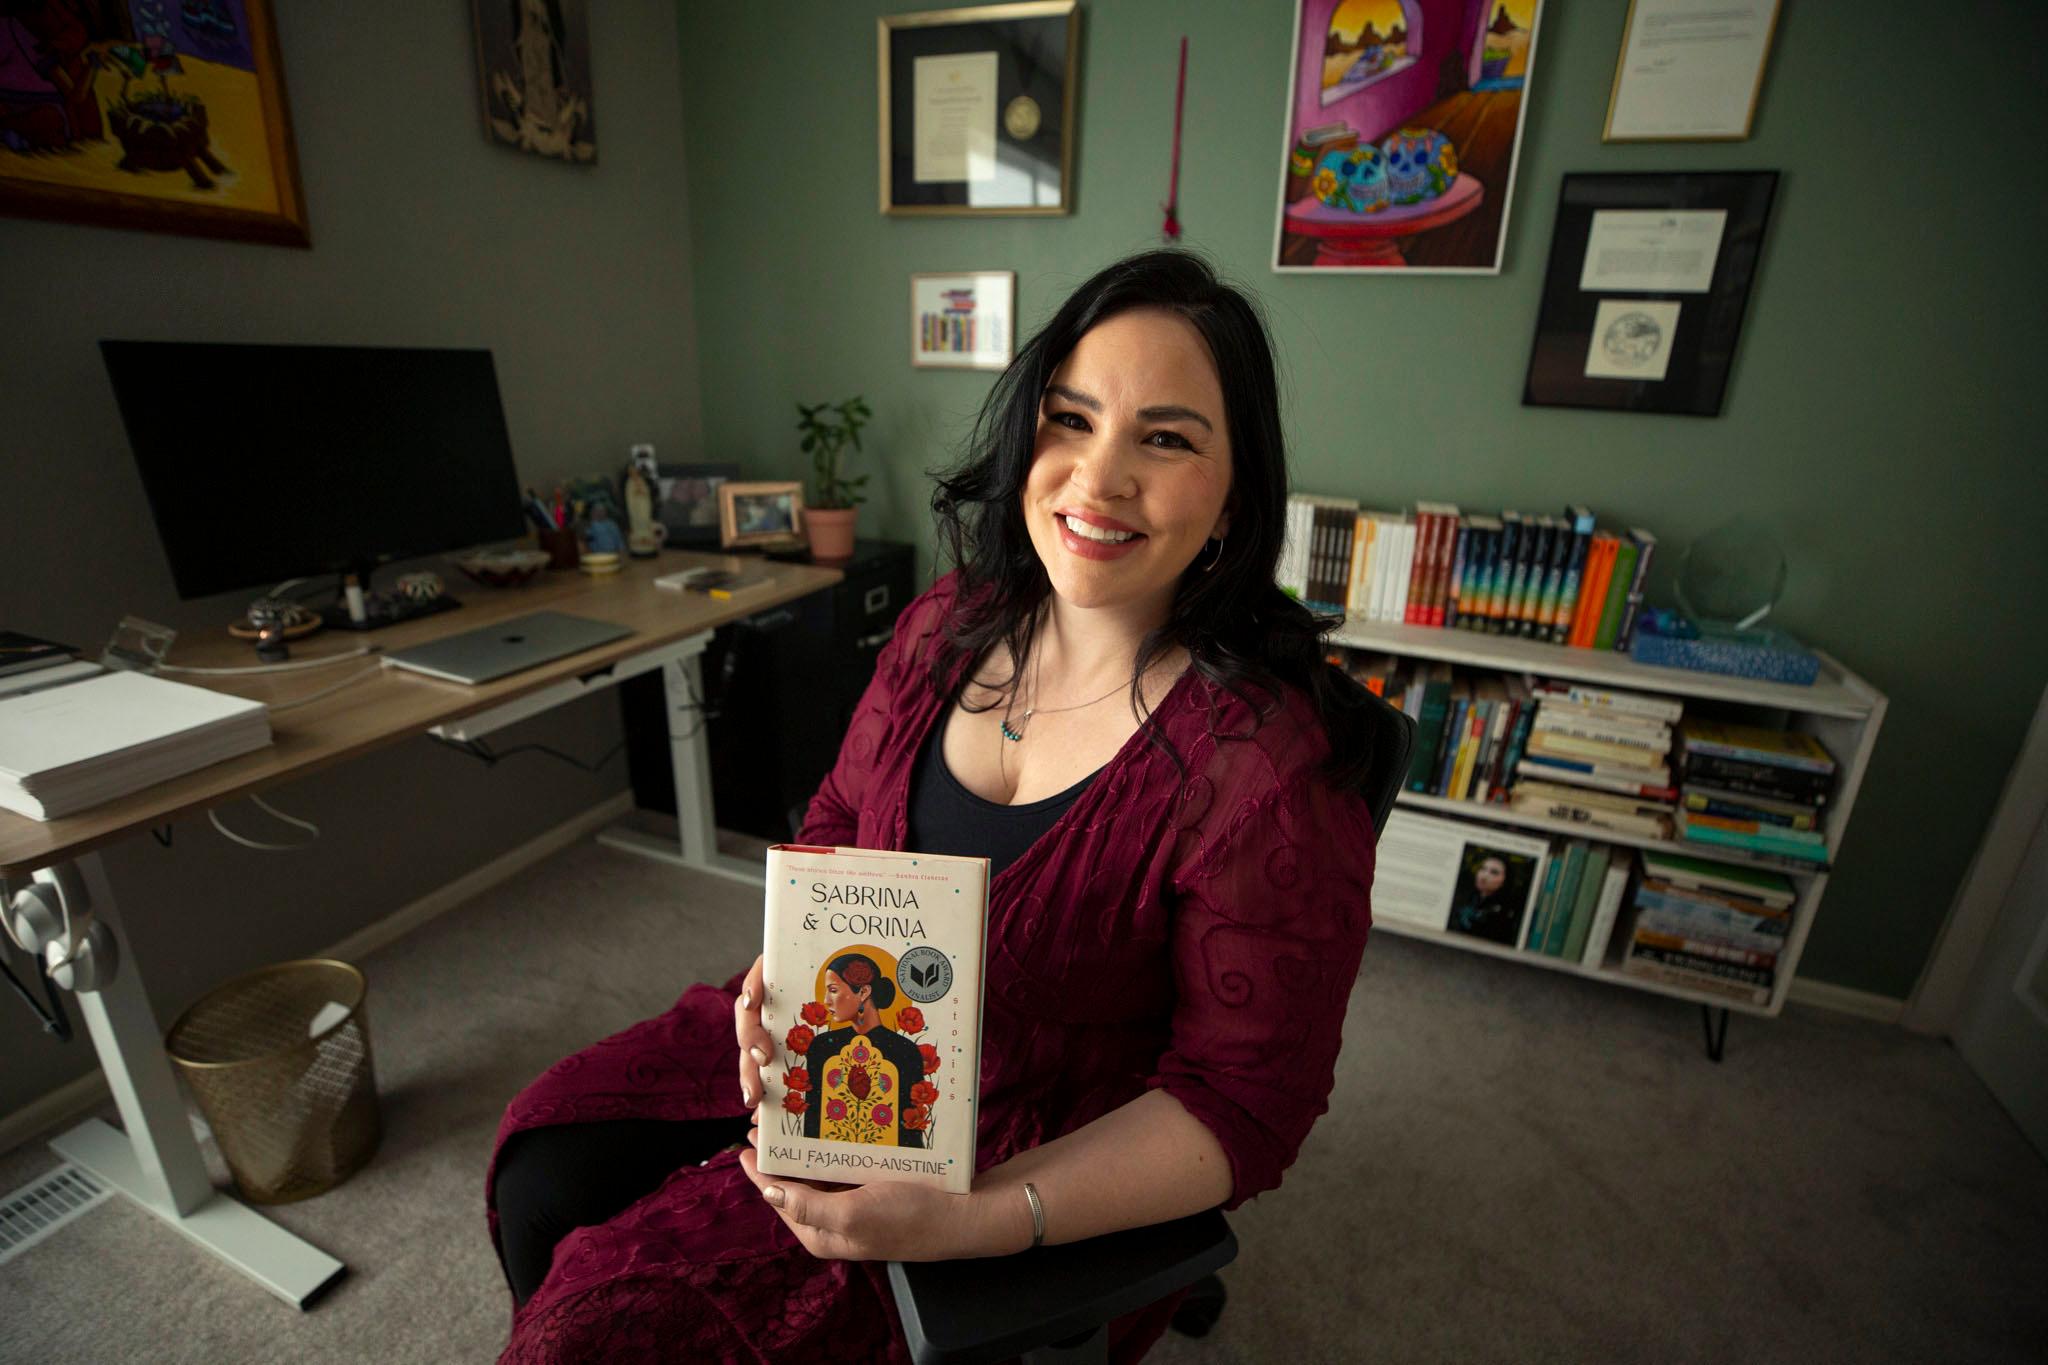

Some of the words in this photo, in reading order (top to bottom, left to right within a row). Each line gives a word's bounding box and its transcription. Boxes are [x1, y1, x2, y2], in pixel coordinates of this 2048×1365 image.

[811, 882, 920, 910] SABRINA
[803, 912, 820, 931] &
[830, 913, 927, 939] CORINA
[900, 950, 920, 984] NATIONAL
[920, 950, 940, 962] BOOK
[939, 960, 951, 988] AWARD
[907, 988, 941, 1001] FINALIST
[768, 1145, 802, 1161] KALI
[807, 1150, 948, 1176] FAJARDO-ANSTINE
